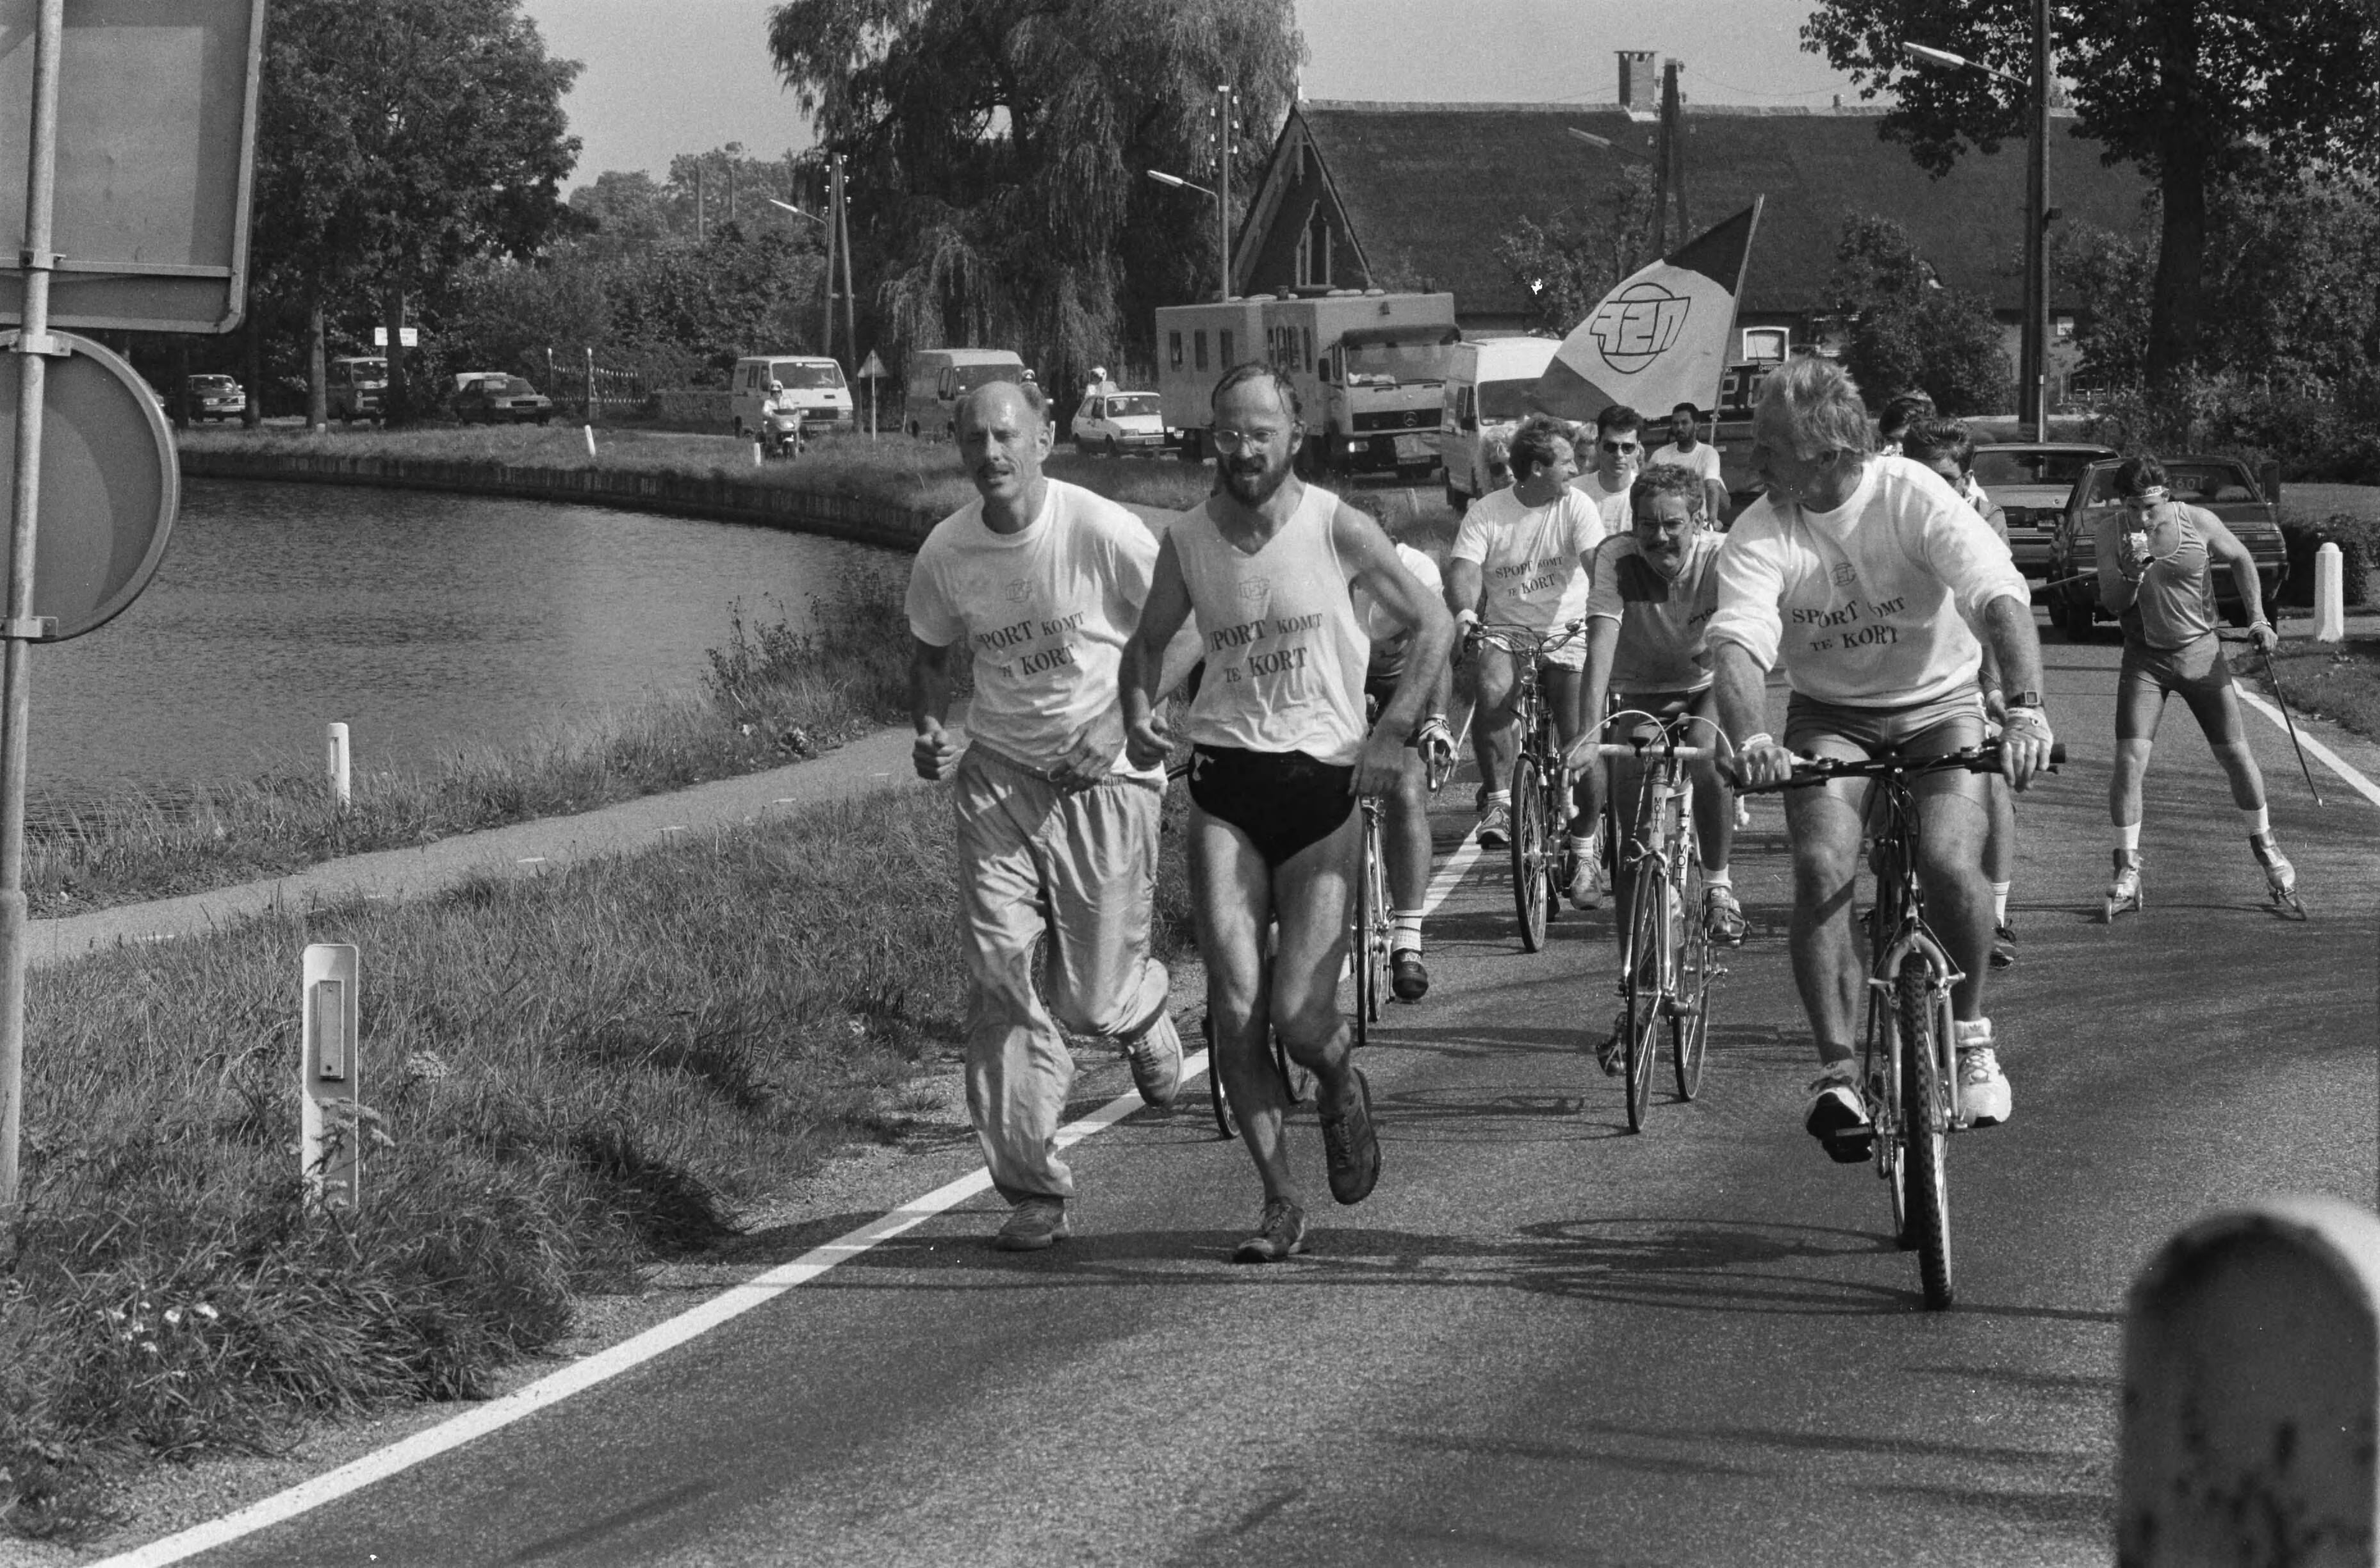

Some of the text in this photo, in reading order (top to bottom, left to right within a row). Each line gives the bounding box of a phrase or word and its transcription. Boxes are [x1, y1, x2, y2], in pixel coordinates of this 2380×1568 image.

[1521, 573, 1555, 594] KORT
[1276, 613, 1322, 634] KOMT
[1792, 600, 1858, 628] SPORT
[976, 611, 1084, 650] PORT KOMT
[1810, 625, 1898, 651] TE KORT
[1021, 644, 1077, 676] KORT
[1224, 647, 1308, 683] TE KORT
[1653, 797, 1662, 833] MOTTA
